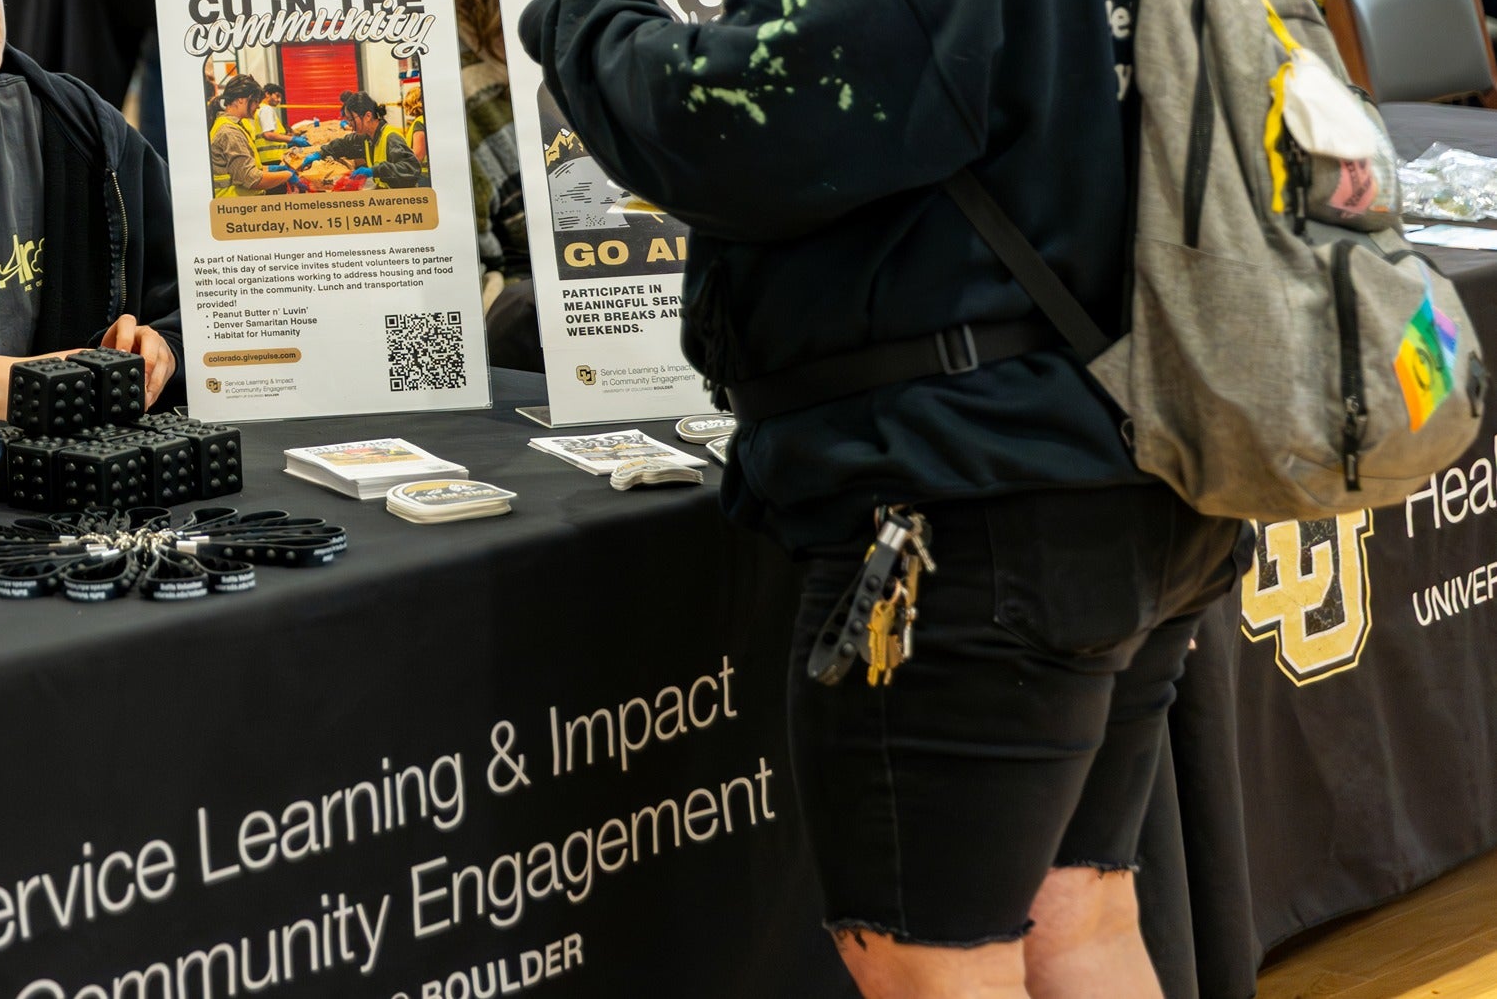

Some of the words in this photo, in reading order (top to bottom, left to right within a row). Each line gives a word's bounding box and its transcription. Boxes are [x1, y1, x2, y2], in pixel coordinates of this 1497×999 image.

[217, 204, 257, 216] Hunger
[261, 202, 281, 212] and
[285, 198, 365, 211] Homelessness
[368, 195, 429, 206] Awareness
[226, 220, 289, 234] Saturday,
[293, 218, 323, 230] Nov.
[327, 217, 342, 228] 15
[353, 214, 382, 227] 9AM
[395, 213, 423, 224] 4PM
[207, 256, 224, 266] part
[237, 254, 271, 262] National
[274, 253, 304, 261] Hunger
[307, 250, 322, 258] and
[325, 248, 386, 258] Homelessness
[389, 246, 435, 254] Awareness
[564, 240, 630, 267] GO
[194, 267, 220, 275] Week,
[241, 265, 255, 274] day
[269, 263, 299, 271] service
[301, 262, 329, 270] invites
[332, 260, 363, 268] student
[365, 258, 409, 267] volunteers
[422, 256, 452, 265] partner
[195, 278, 213, 286] with
[216, 277, 235, 285] local
[238, 275, 295, 285] organizations
[297, 273, 330, 281] working
[344, 271, 377, 279] address
[380, 268, 414, 278] housing
[416, 267, 431, 275] and
[434, 266, 453, 274] food
[196, 289, 237, 297] insecurity
[266, 285, 315, 294] community.
[318, 283, 344, 291] Lunch
[364, 279, 423, 289] transportation
[563, 285, 644, 298] PARTICIPATE
[649, 284, 662, 293] IN
[197, 300, 237, 310] provided!
[564, 298, 648, 311] MEANINGFUL
[245, 309, 270, 317] Butter
[283, 307, 309, 315] Luvin'
[565, 313, 600, 323] OVER
[604, 310, 655, 321] BREAKS
[246, 319, 288, 327] Samaritan
[291, 317, 318, 325] House
[214, 331, 244, 339] Habitat
[261, 328, 301, 337] Humanity
[567, 324, 643, 336] WEEKENDS.
[209, 352, 296, 362] colorado.givepulse.com
[601, 367, 627, 376] Service
[628, 366, 658, 375] Learning
[667, 364, 692, 373] Impact
[609, 377, 650, 387] Community
[652, 374, 696, 385] Engagement
[231, 387, 262, 395] Community
[263, 385, 296, 393] Engagement
[197, 753, 466, 886] Learning
[486, 719, 532, 794] &
[549, 654, 738, 777] Impact
[410, 757, 775, 938] Engagement
[421, 932, 584, 999] BOULDER
